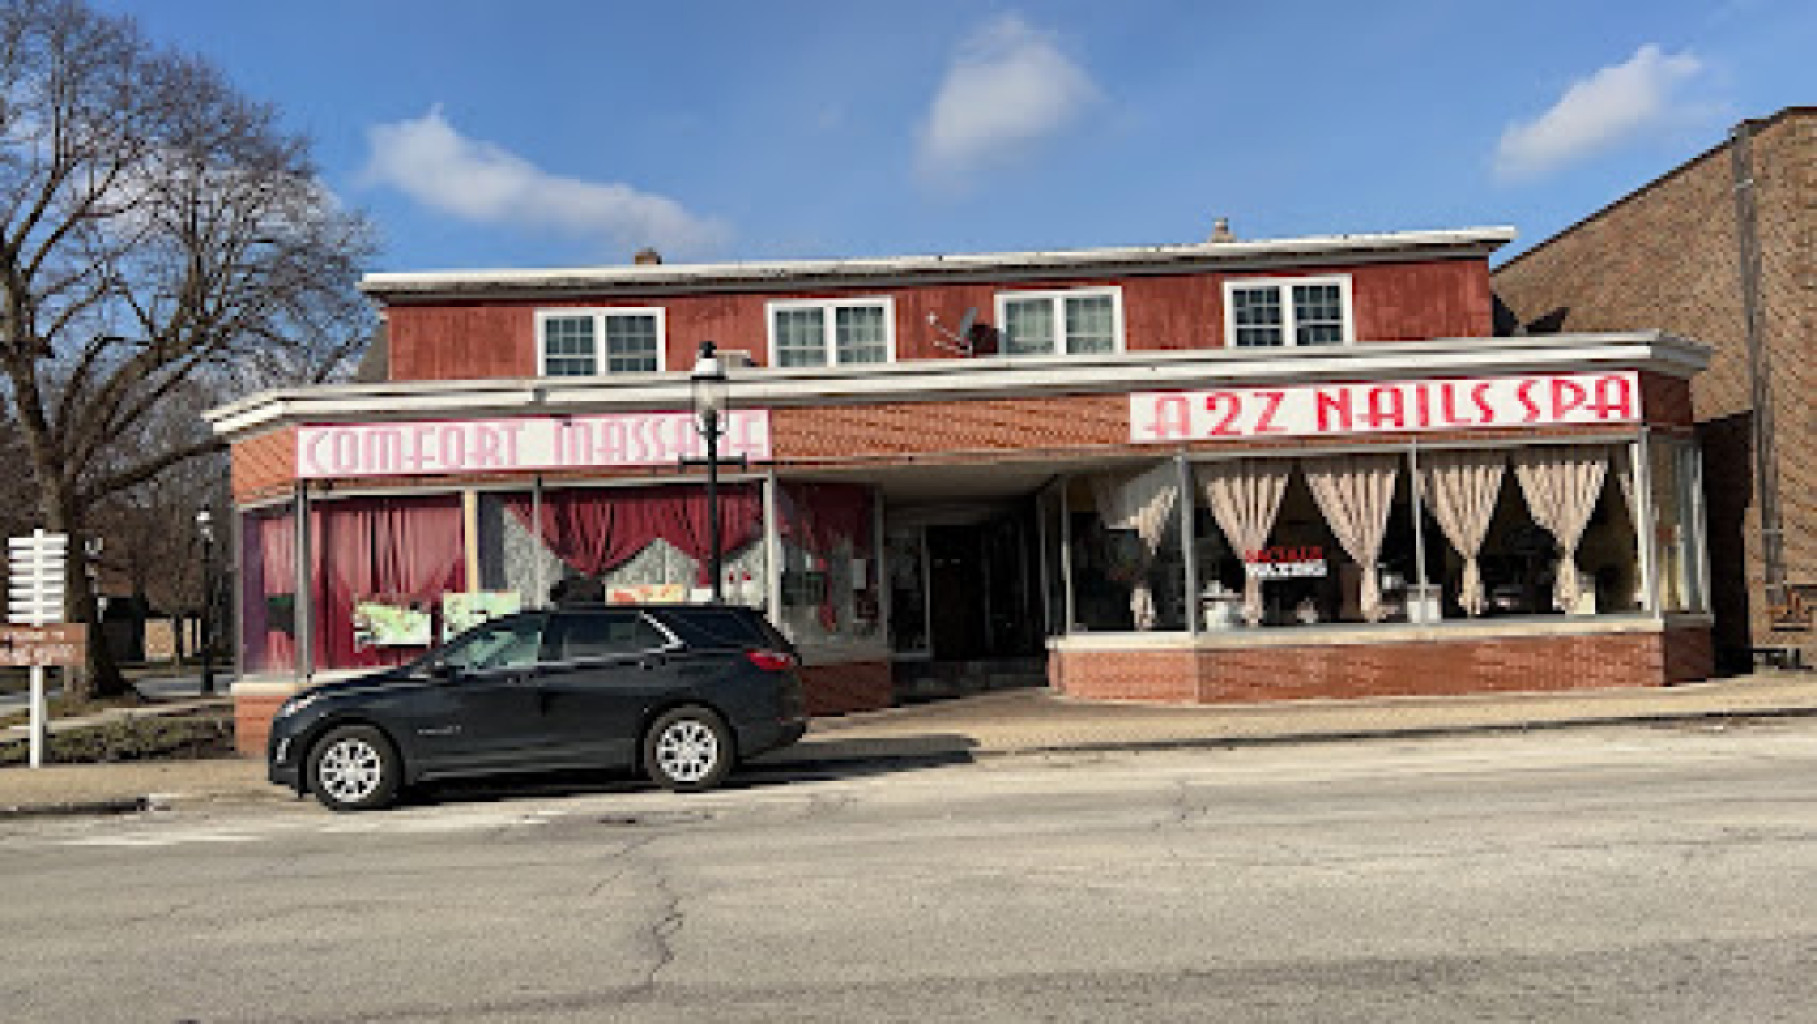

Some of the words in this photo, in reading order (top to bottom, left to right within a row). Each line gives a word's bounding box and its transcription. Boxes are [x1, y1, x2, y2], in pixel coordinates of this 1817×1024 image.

[1144, 391, 1287, 437] A2Z
[1316, 384, 1496, 431] NAILS
[1515, 376, 1631, 421] SPA
[306, 424, 525, 472] COMFORT
